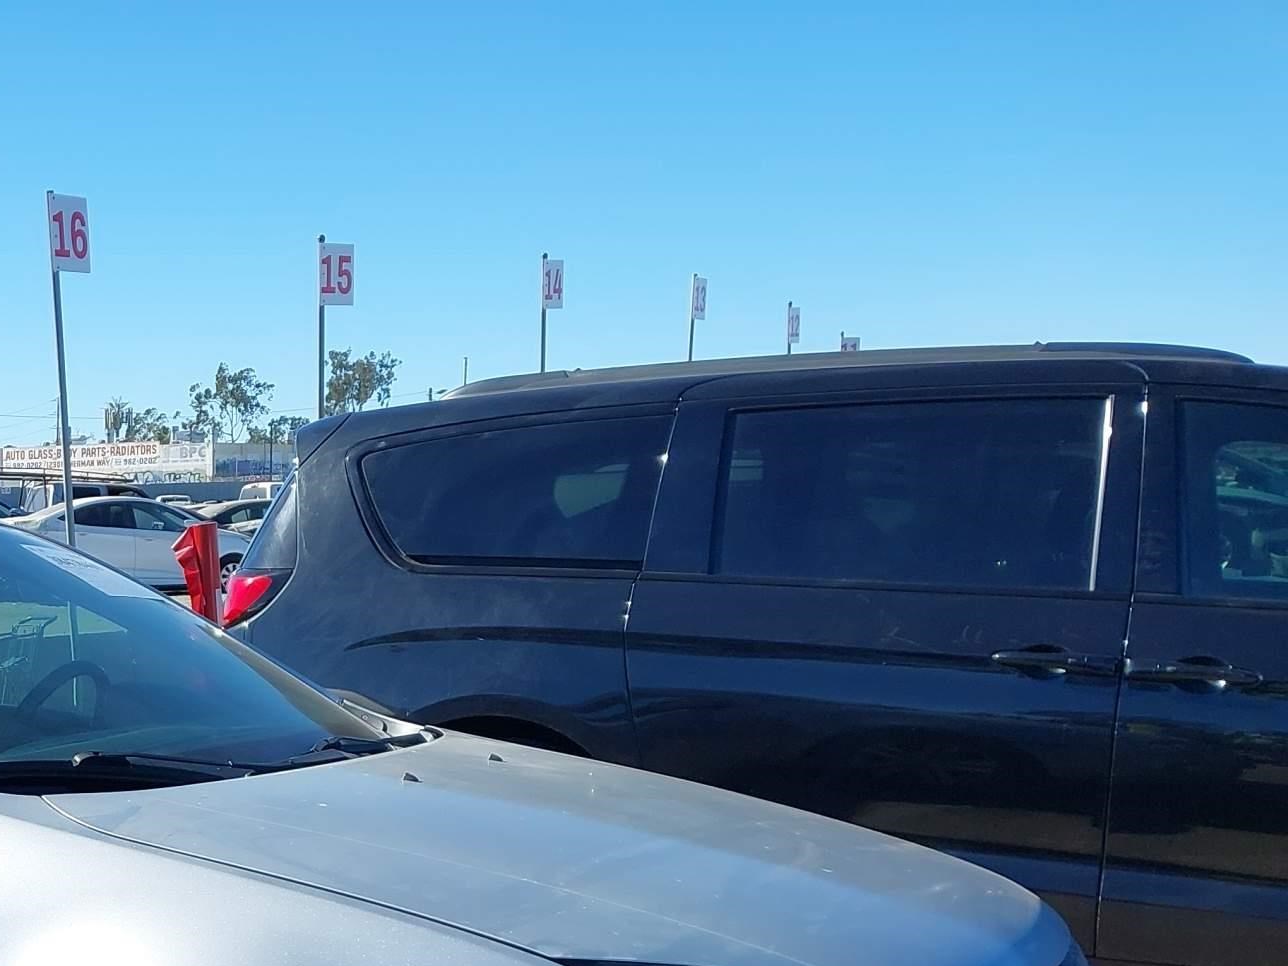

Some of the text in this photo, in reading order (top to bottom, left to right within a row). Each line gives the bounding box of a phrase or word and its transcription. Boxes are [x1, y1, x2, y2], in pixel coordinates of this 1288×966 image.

[53, 210, 88, 259] 16
[321, 255, 352, 295] 15
[545, 269, 563, 300] 14
[695, 286, 707, 313] 13
[790, 314, 800, 337] 12
[5, 450, 25, 460] AUTO
[28, 448, 76, 460] GLASS-BY
